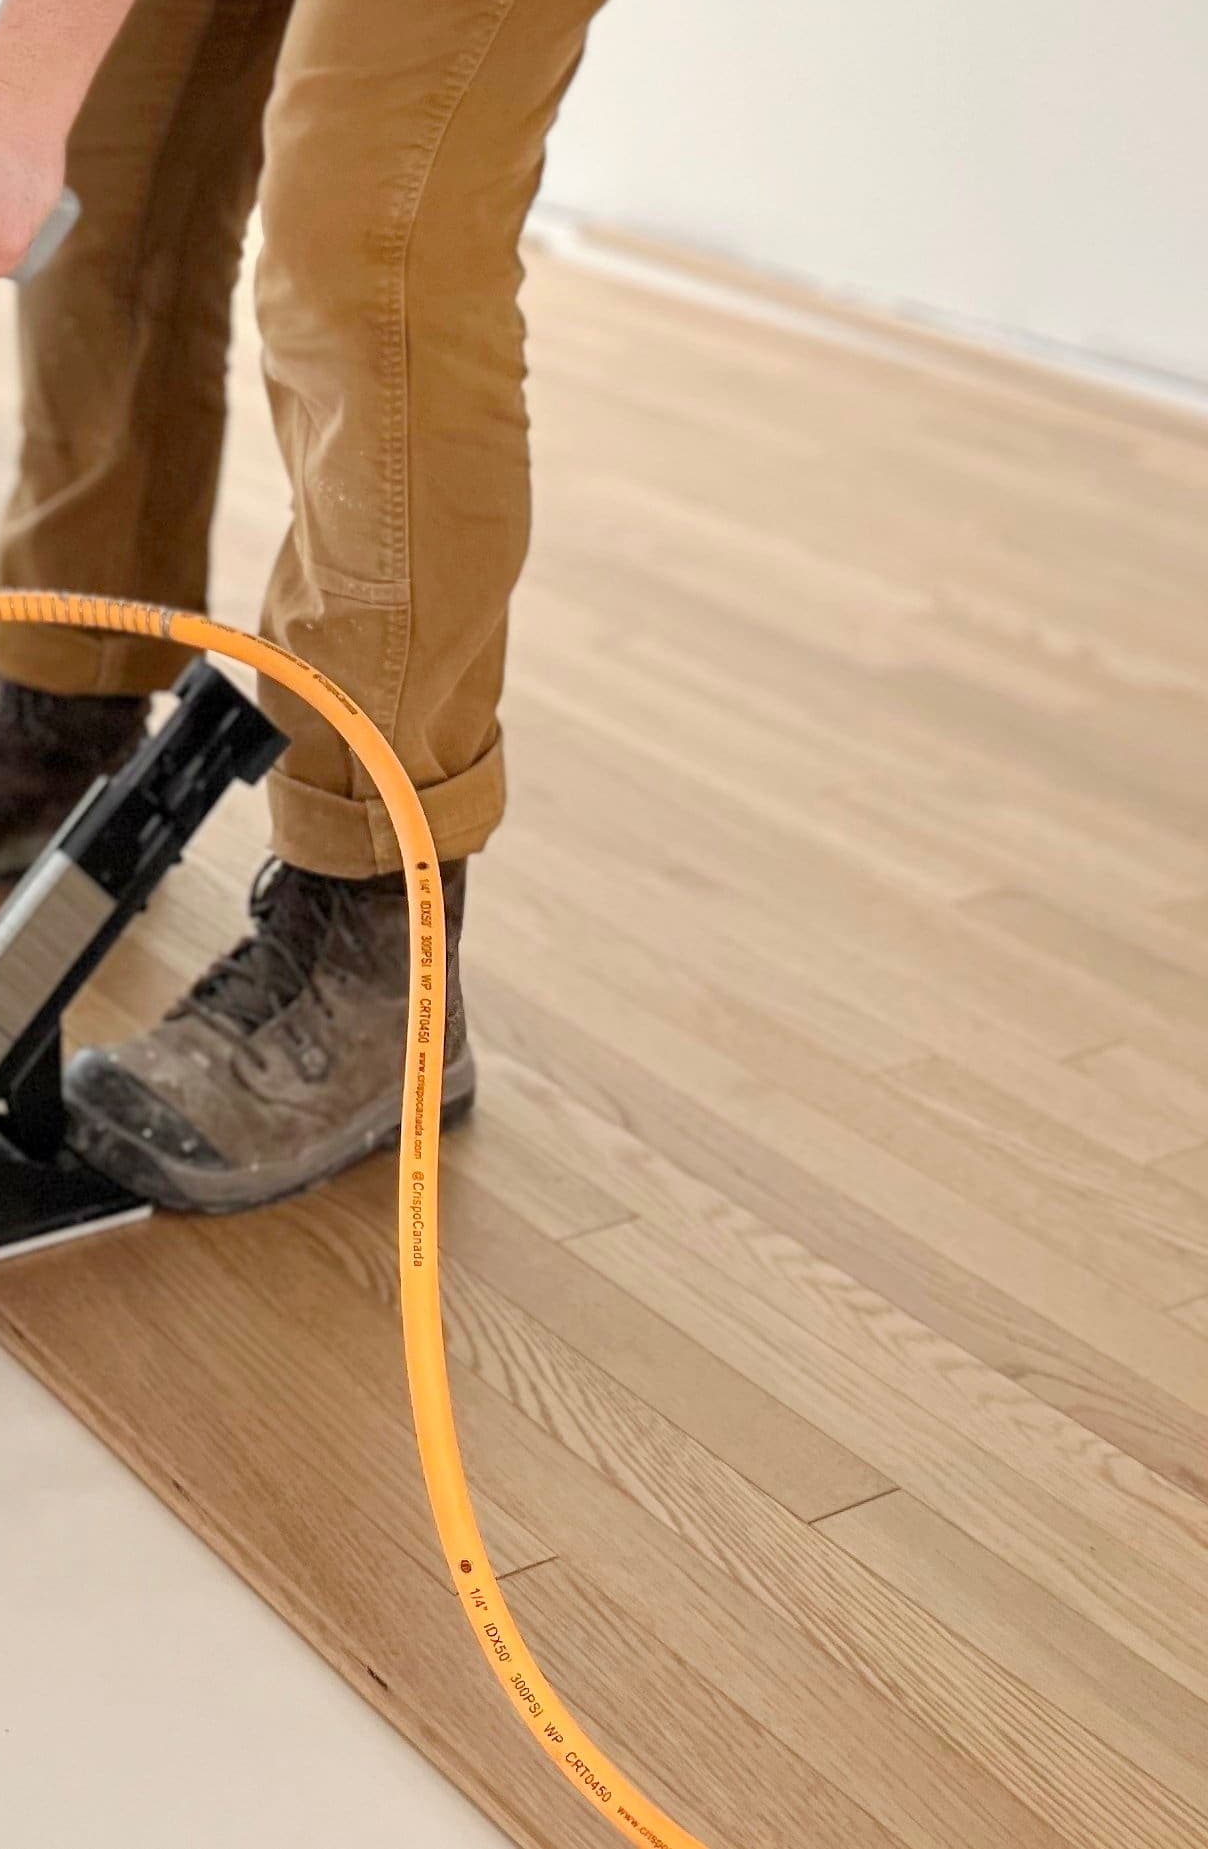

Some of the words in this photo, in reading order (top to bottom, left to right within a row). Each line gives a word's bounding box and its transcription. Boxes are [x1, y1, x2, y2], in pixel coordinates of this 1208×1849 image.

[420, 935, 433, 968] 300PSI
[420, 974, 432, 991] WP
[417, 998, 431, 1044] CRT0450
[413, 1051, 426, 1160] www.crispocanada.com
[410, 1170, 425, 1267] @CrispoCanada
[469, 1587, 489, 1612] 1/4"
[510, 1673, 544, 1719] 300PSI
[543, 1722, 564, 1745] WP
[564, 1751, 613, 1804] CRT0450
